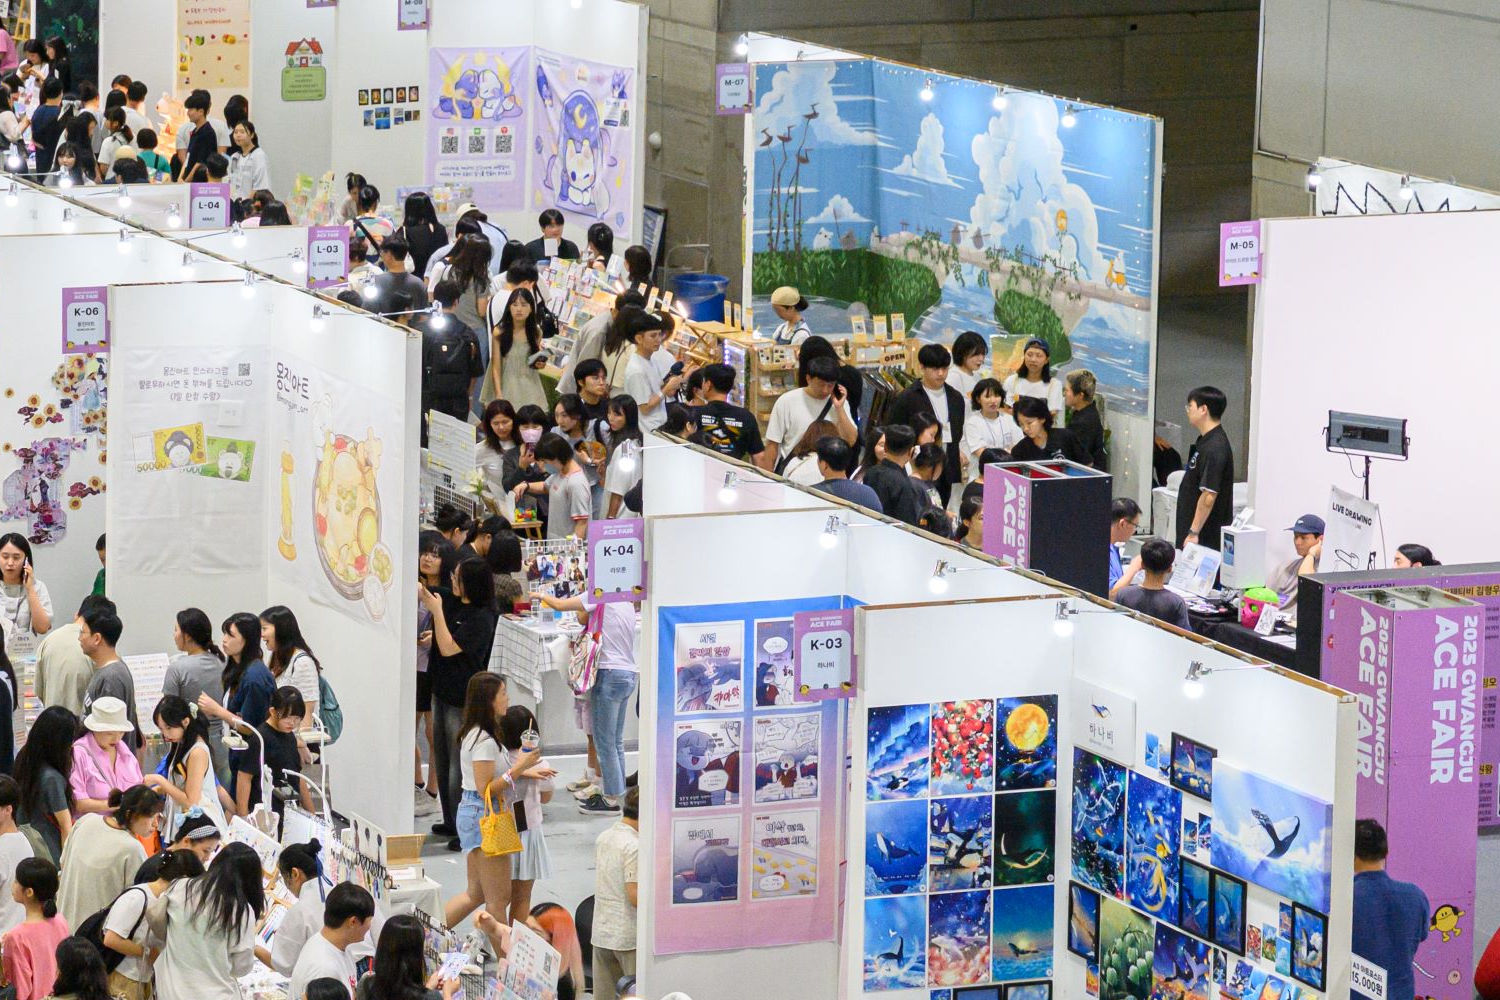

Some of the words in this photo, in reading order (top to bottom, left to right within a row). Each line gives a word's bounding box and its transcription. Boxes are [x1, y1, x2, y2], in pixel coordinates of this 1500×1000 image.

[198, 201, 219, 209] L-04
[316, 245, 338, 253] L-03
[1230, 241, 1253, 250] M-05
[74, 307, 99, 316] K-06
[884, 352, 905, 362] OPEN
[1003, 478, 1017, 548] ACE
[1017, 485, 1026, 528] 2025
[1332, 502, 1344, 514] LIVE
[1345, 506, 1372, 527] DRAWING
[604, 545, 634, 556] K-04
[810, 638, 842, 651] K-03
[1358, 606, 1376, 687] ACE
[1378, 615, 1389, 668] 2025
[1433, 614, 1459, 691] ACE
[1463, 614, 1478, 667] 2025
[1356, 692, 1374, 779] FAIR
[1374, 669, 1387, 786] GWANGJU
[1430, 700, 1456, 785] FAIR
[1458, 668, 1476, 783] GWANGJU
[1352, 971, 1382, 997] 15,000원
